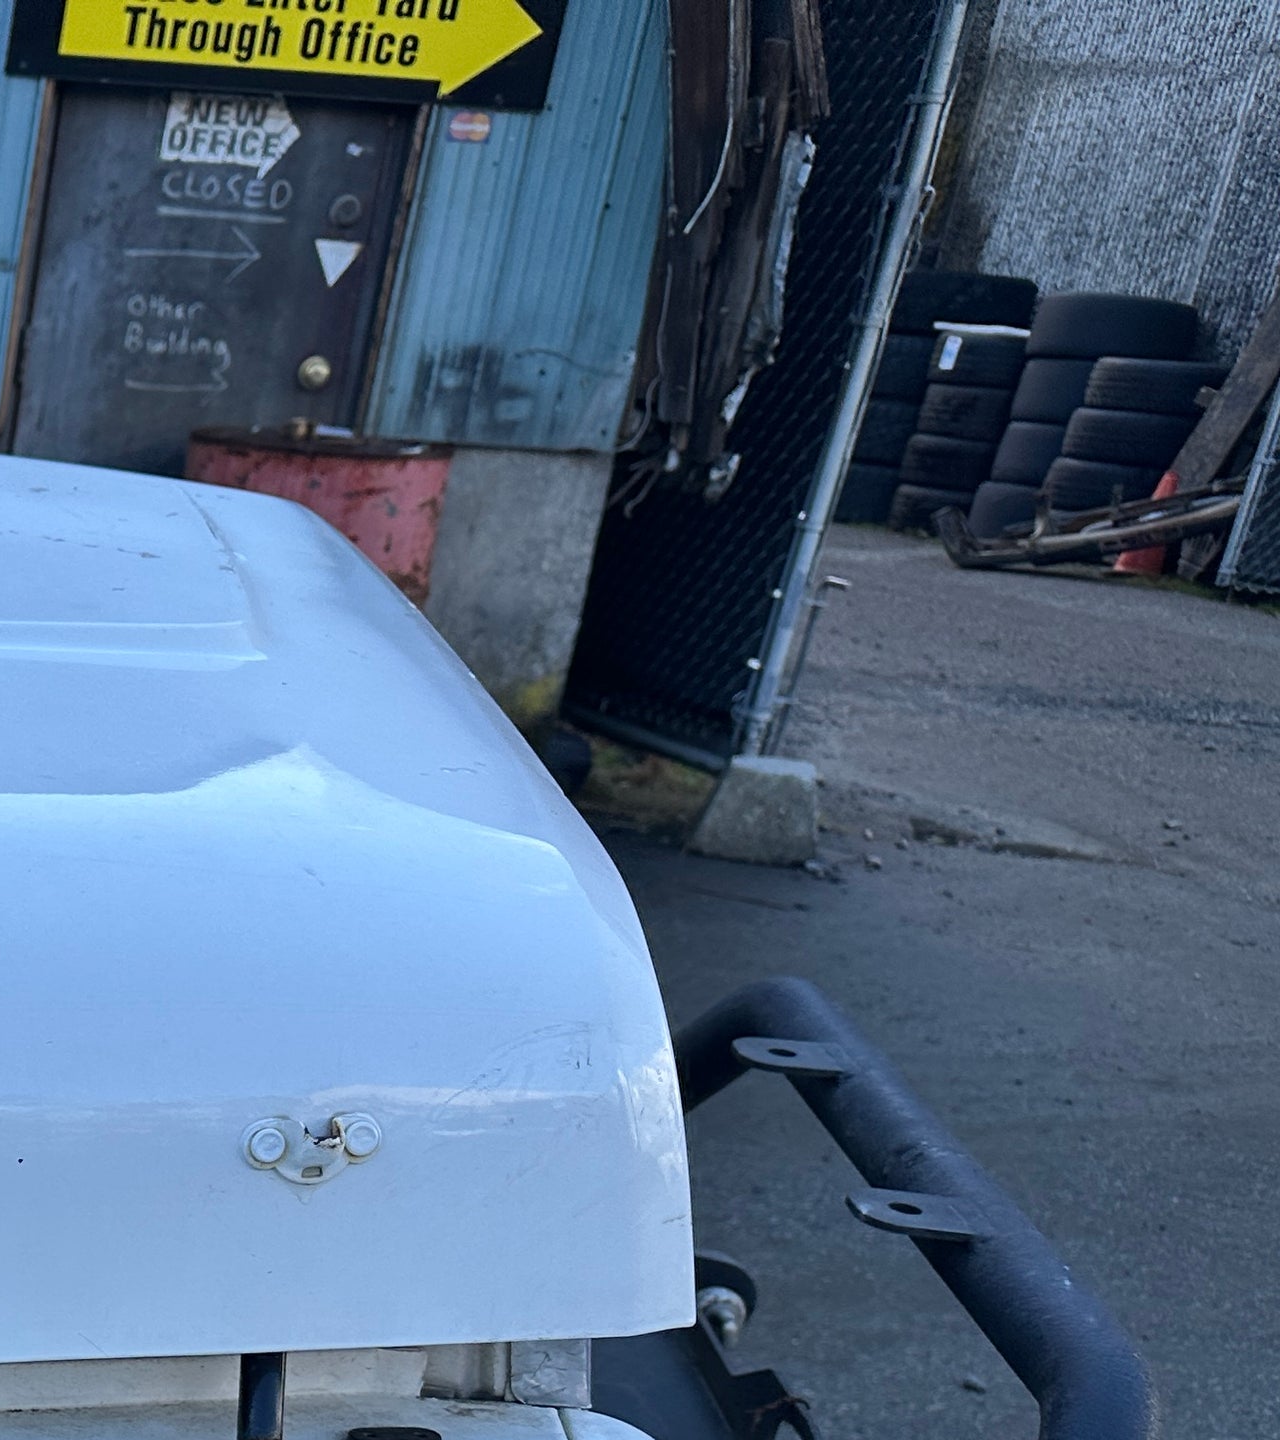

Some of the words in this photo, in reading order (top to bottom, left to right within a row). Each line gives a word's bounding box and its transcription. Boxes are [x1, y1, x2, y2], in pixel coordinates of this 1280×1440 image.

[125, 6, 282, 62] Through
[300, 17, 420, 66] Office
[187, 97, 266, 127] NEW
[168, 122, 282, 158] OFFICE
[161, 170, 293, 210] CLOSED
